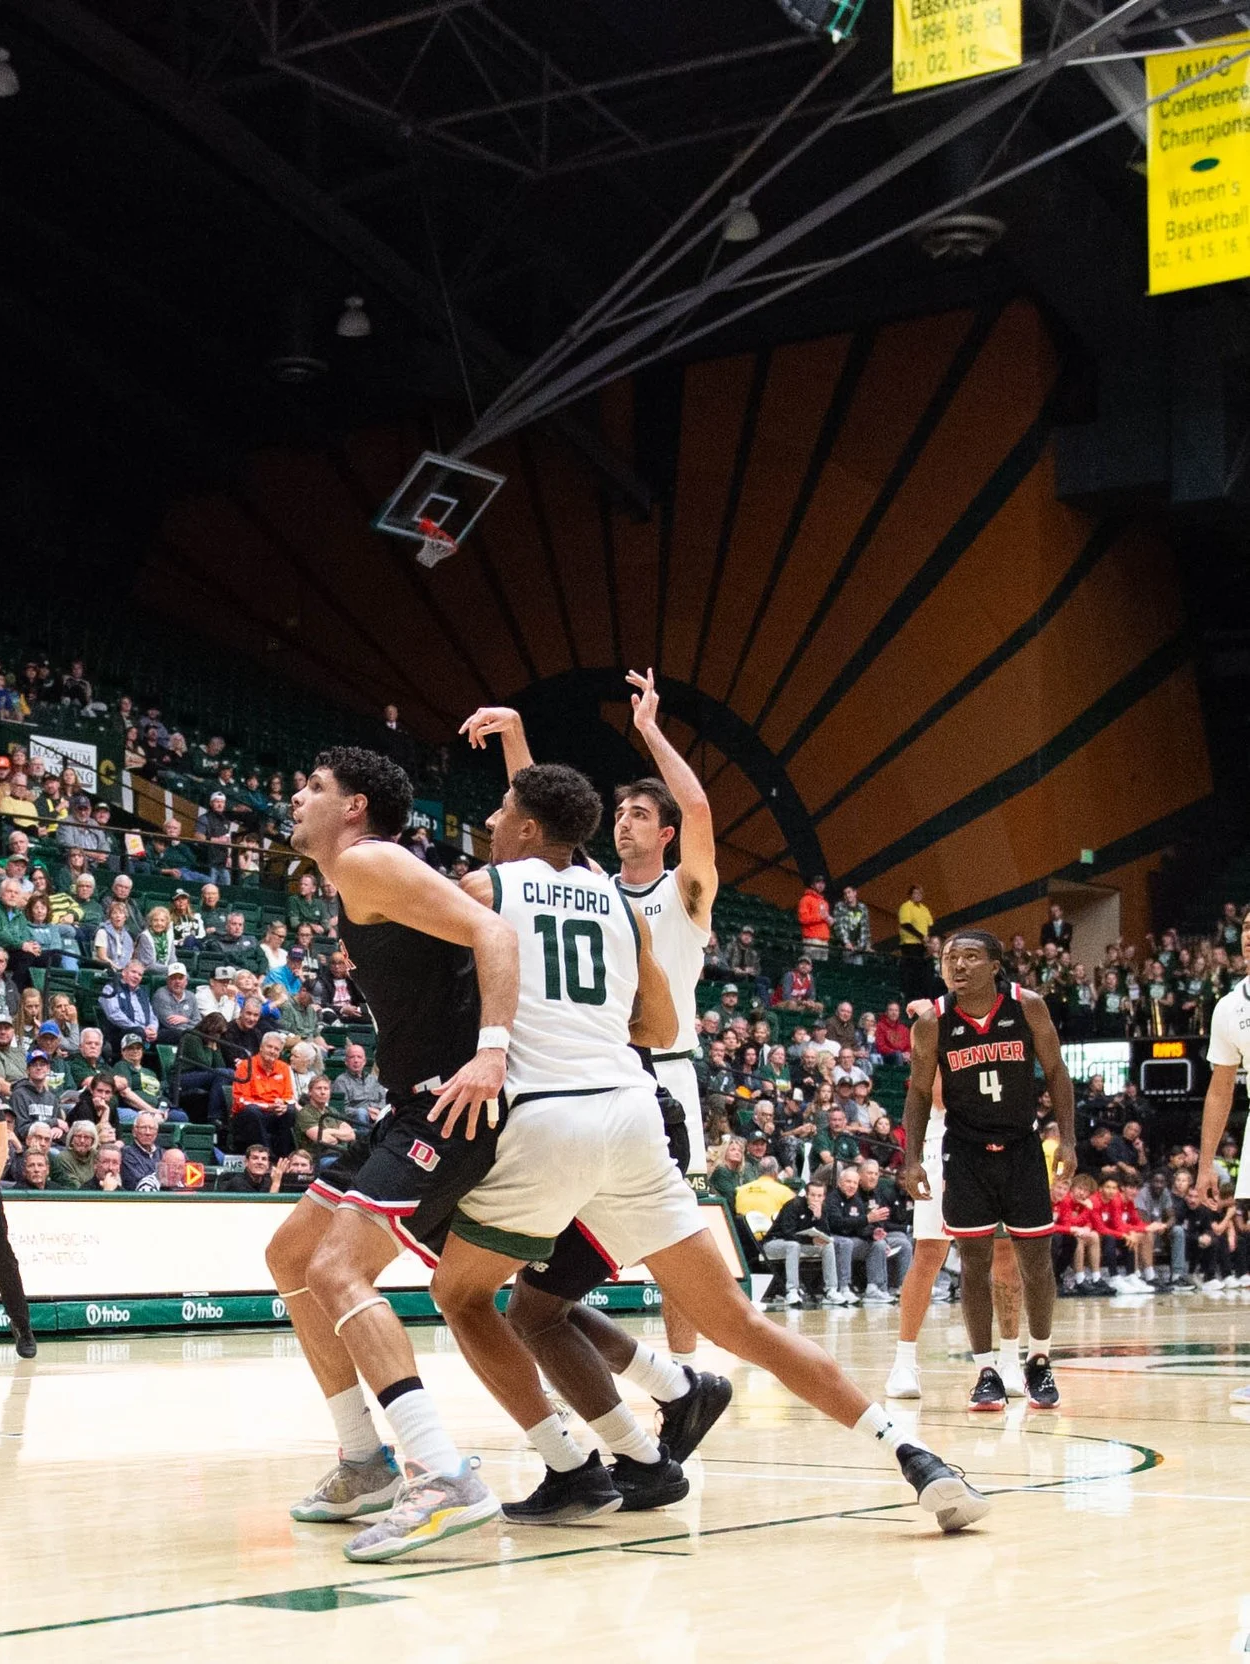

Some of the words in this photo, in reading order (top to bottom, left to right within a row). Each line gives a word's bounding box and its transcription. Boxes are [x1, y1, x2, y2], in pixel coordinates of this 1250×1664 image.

[1159, 85, 1249, 119] Conference
[1166, 180, 1241, 209] Women's
[1165, 204, 1248, 242] Basketball
[32, 746, 91, 765] MAXMUM
[98, 759, 117, 786] C
[445, 813, 459, 838] B
[523, 882, 610, 915] CLIFFORD
[534, 913, 607, 1006] 10
[947, 1040, 1025, 1072] DENVER
[979, 1070, 1003, 1103] 4
[684, 1176, 706, 1190] MS
[10, 1233, 37, 1247] EAM
[197, 1302, 224, 1318] fnbo
[587, 1290, 609, 1305] fnbo
[101, 1305, 130, 1322] fnbo
